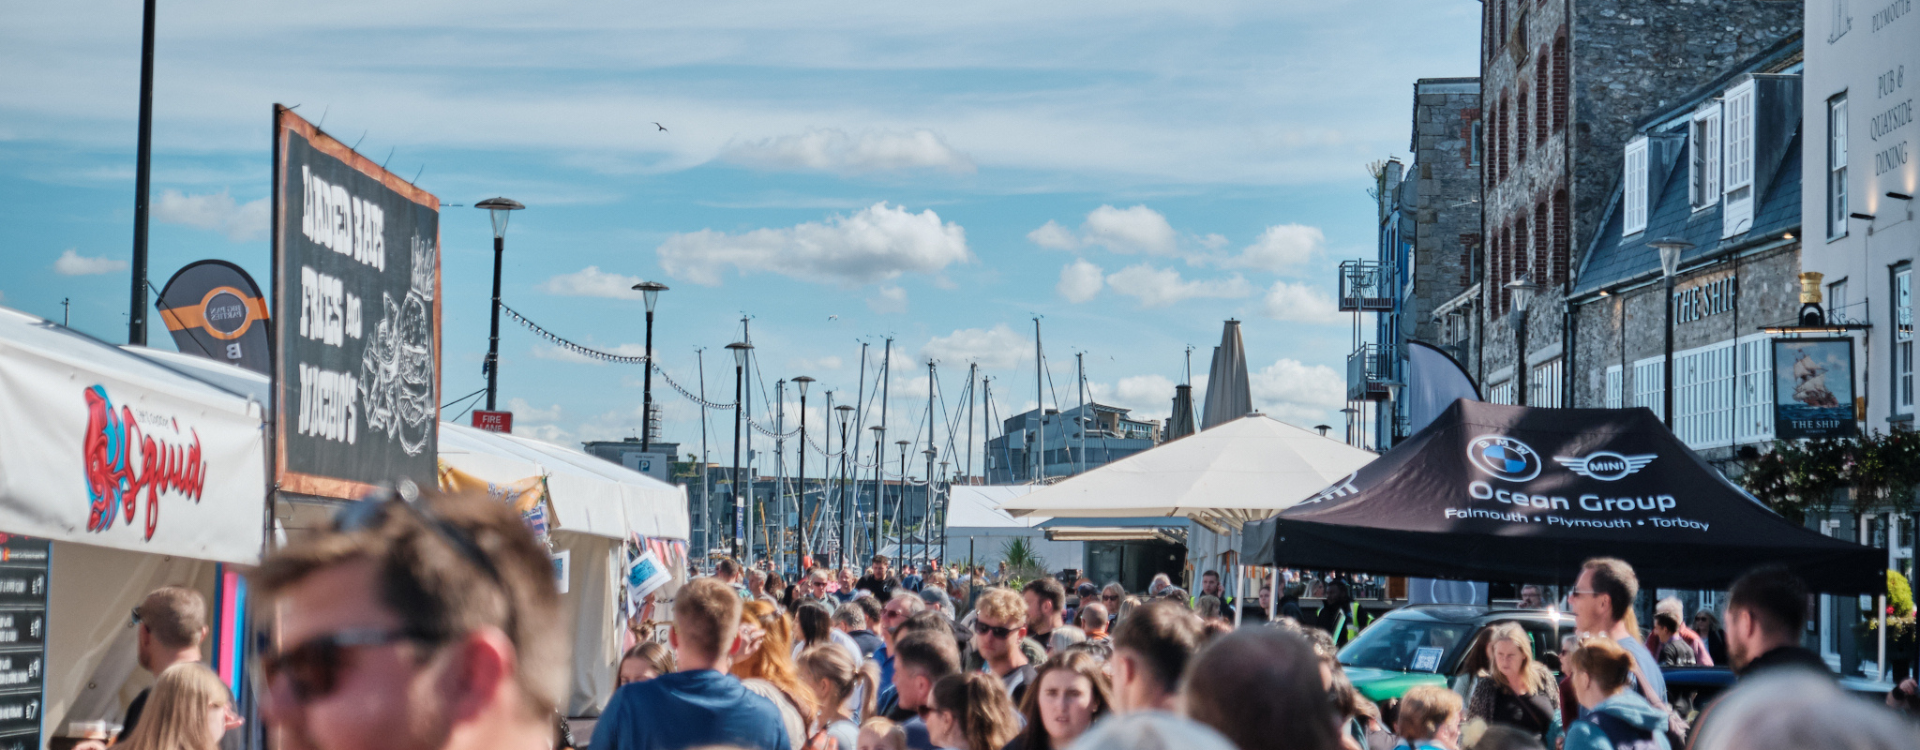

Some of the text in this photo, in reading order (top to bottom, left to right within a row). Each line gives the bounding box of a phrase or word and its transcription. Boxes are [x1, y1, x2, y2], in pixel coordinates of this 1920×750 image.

[1878, 69, 1895, 99] PUB
[1870, 98, 1913, 142] QUAYSIDE
[1875, 140, 1908, 177] DINING
[300, 264, 363, 349] FRIES AND
[1673, 274, 1737, 326] THE SHIP
[297, 362, 358, 446] NACHO'S
[482, 414, 502, 424] FIRE
[1792, 420, 1841, 429] THE SHIP
[1477, 438, 1531, 456] BMW
[121, 404, 207, 544] Squid
[1589, 461, 1625, 472] MINI
[1468, 480, 1677, 512] Ocean Group
[1444, 507, 1710, 532] Falmouth Plymouth Torbay
